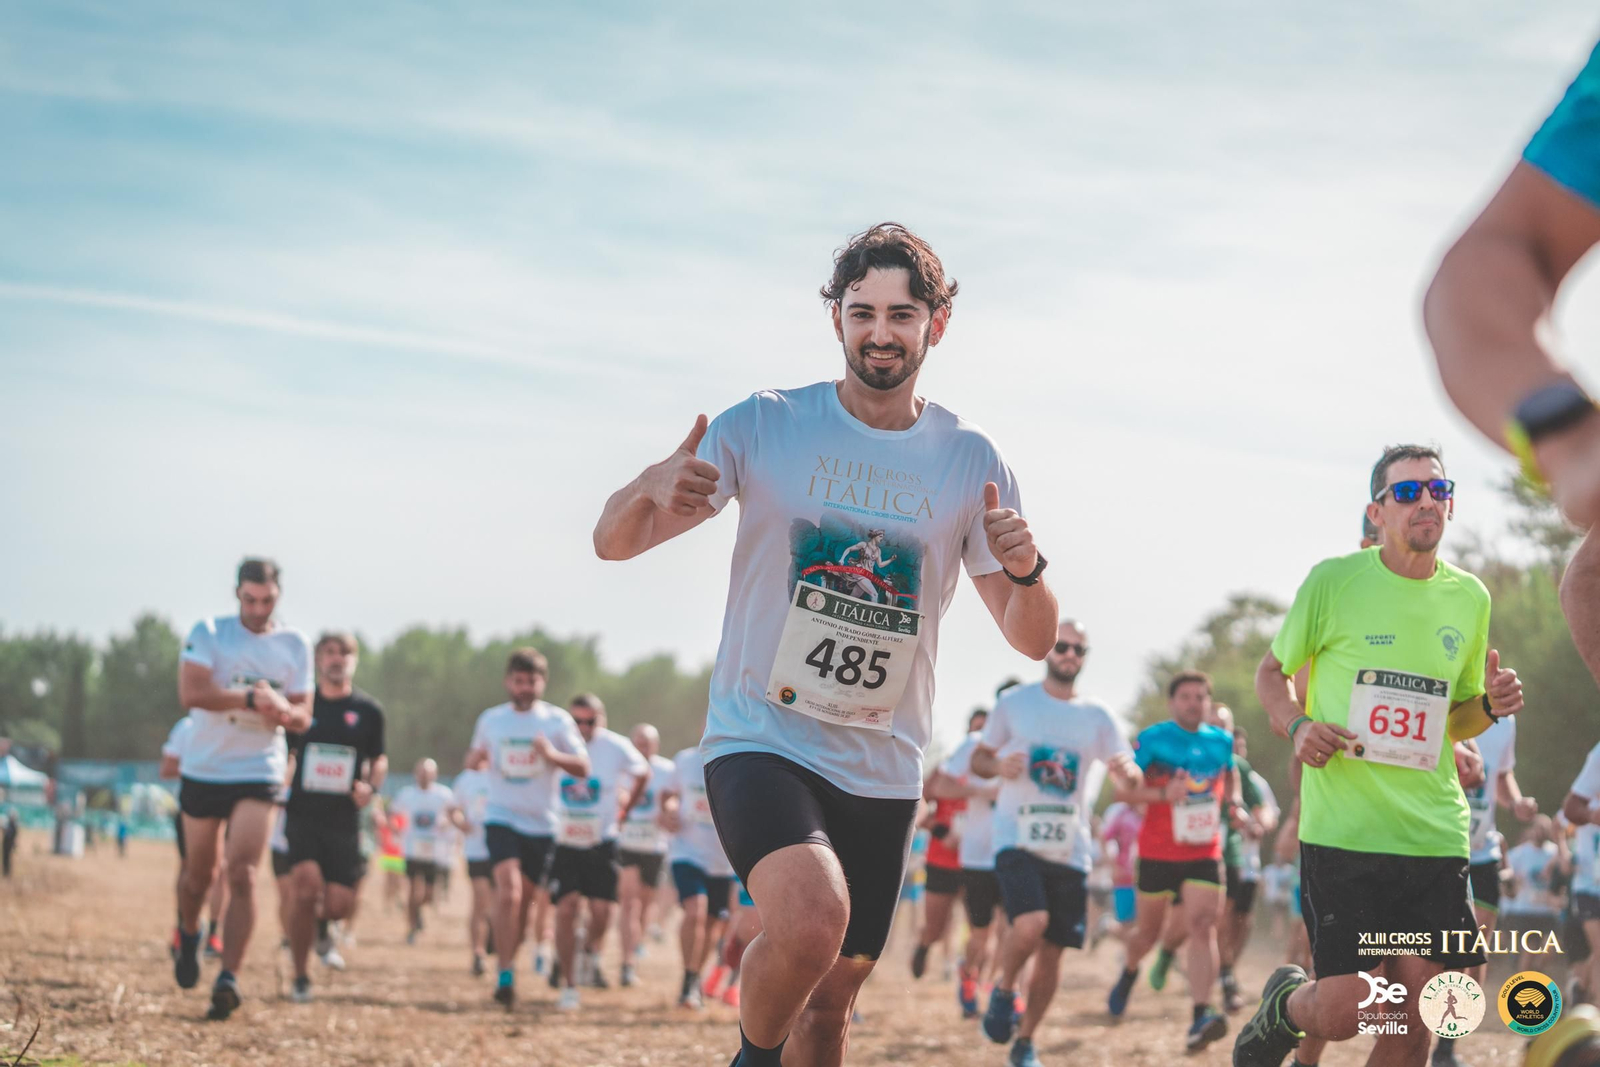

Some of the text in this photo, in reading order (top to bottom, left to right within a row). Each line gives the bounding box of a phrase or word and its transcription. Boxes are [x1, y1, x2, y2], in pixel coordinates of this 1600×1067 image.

[873, 466, 922, 486] CROSS
[871, 510, 889, 519] CROSS
[890, 513, 918, 524] COUNTRY
[833, 601, 890, 626] ITÁLICA
[811, 617, 837, 629] ANTONIO
[837, 624, 861, 636] JURADO
[836, 631, 879, 645] INDEPENDIENTE
[805, 637, 891, 690] 485
[1369, 704, 1427, 741] 631
[1029, 822, 1066, 841] 826
